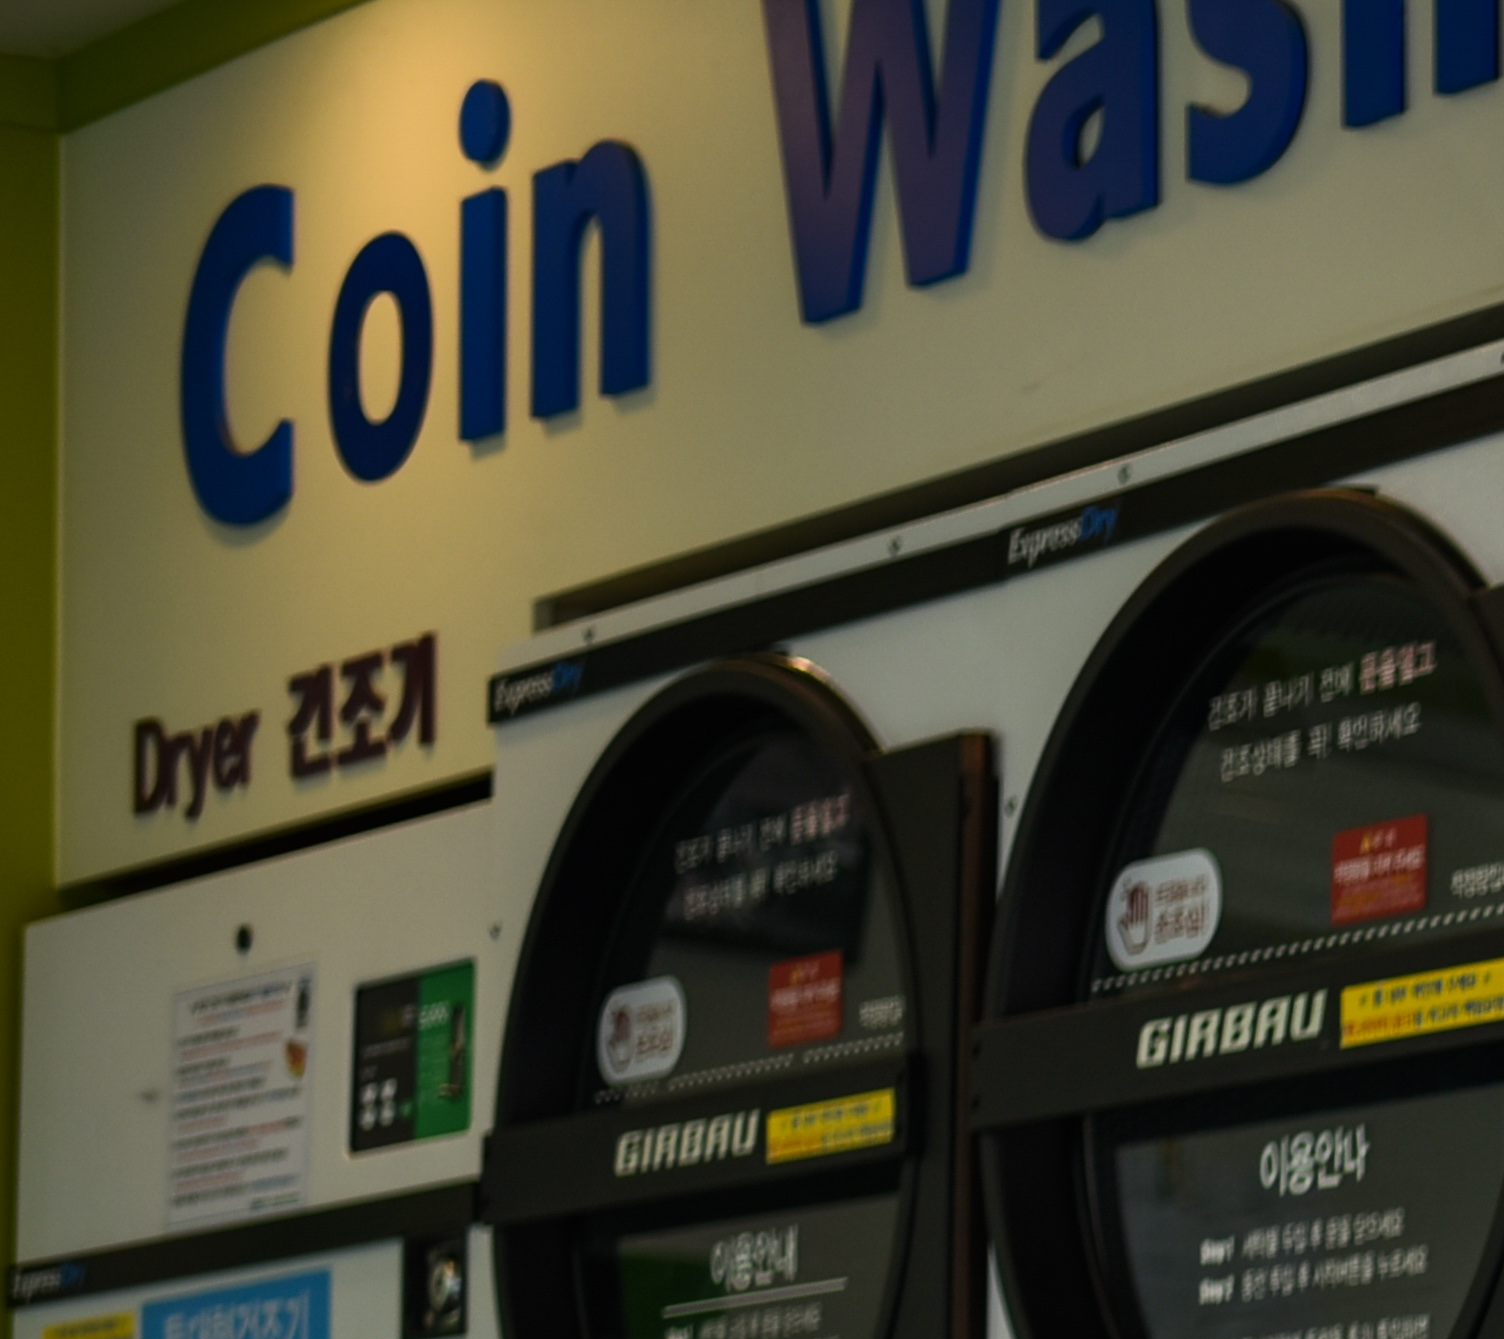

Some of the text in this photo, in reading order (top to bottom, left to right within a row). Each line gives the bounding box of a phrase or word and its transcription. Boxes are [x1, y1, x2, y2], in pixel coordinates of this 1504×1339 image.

[180, 79, 653, 526] Coin
[133, 632, 438, 819] Dryer 건조기
[1135, 989, 1328, 1071] GIRBAU
[613, 1109, 762, 1178] GIRBAU
